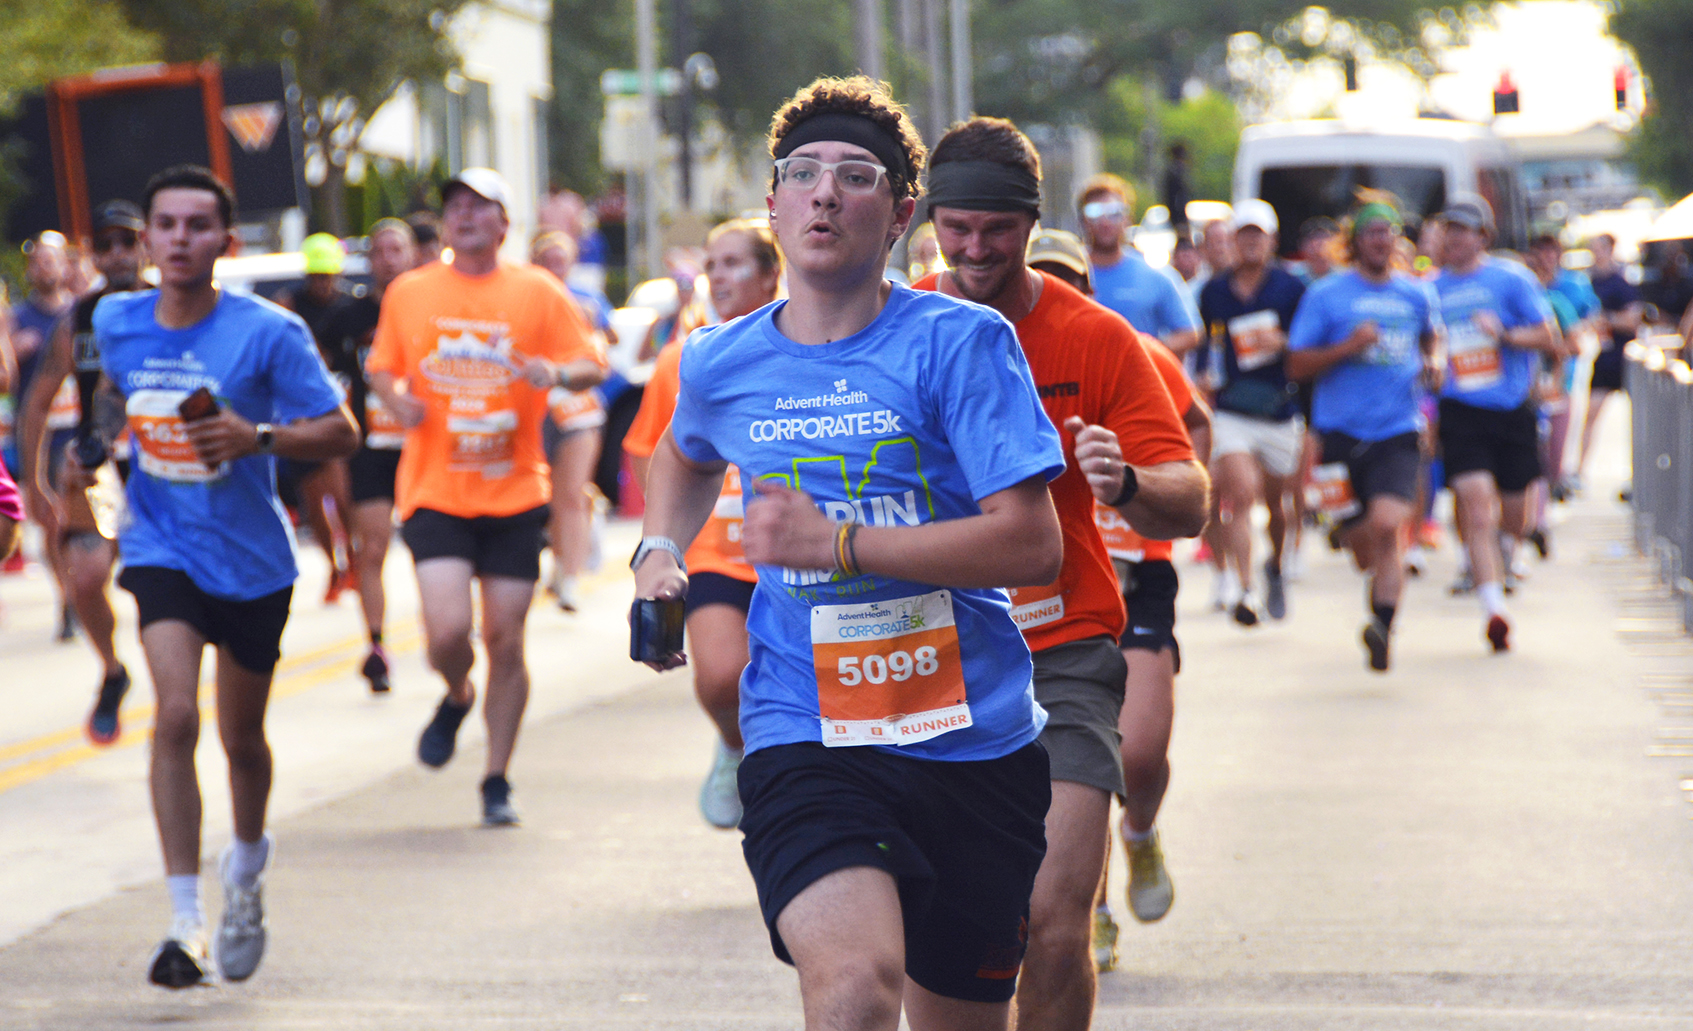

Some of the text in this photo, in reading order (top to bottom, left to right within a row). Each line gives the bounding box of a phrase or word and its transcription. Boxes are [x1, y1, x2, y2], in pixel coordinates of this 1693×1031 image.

[1013, 604, 1061, 623] RUNNER
[837, 645, 939, 686] 5098
[901, 714, 968, 736] RUNNER
